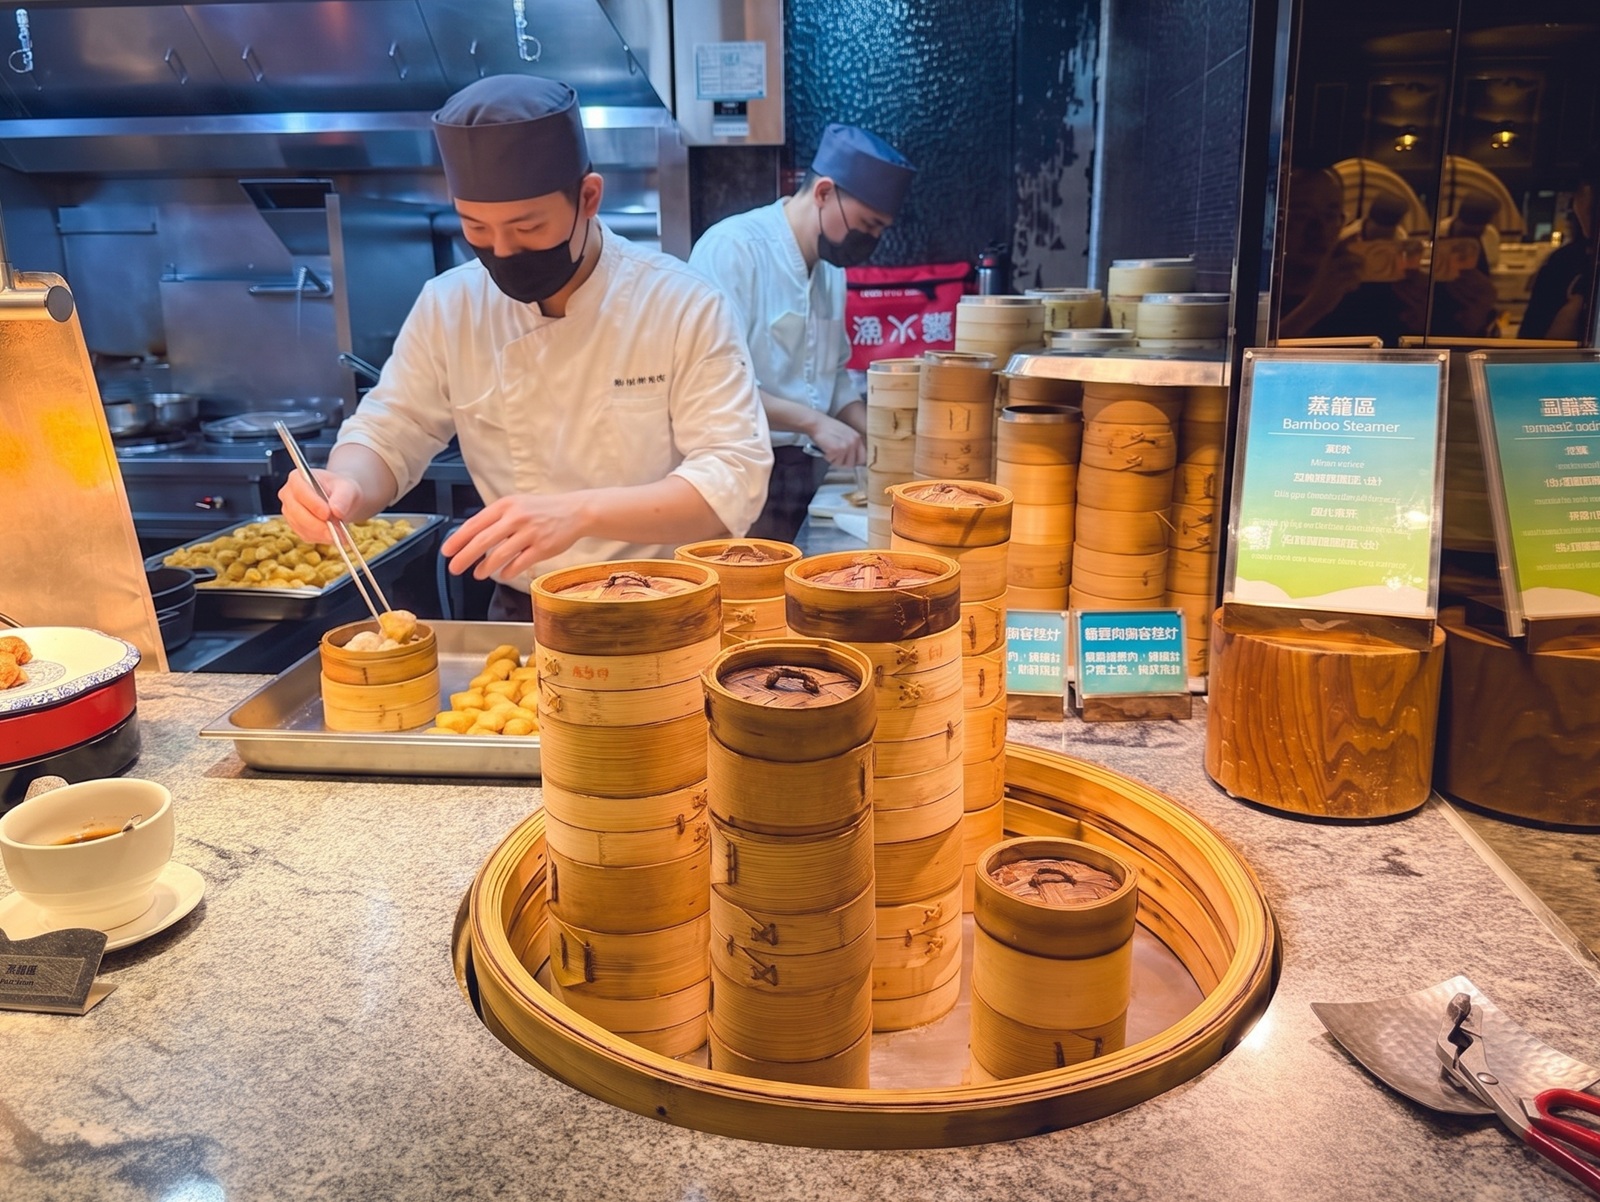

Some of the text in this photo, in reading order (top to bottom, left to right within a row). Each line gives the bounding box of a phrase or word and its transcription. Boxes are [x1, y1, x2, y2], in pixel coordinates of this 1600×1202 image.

[1307, 395, 1377, 417] 蒸籠區
[1282, 418, 1400, 433] Bamboo Steamer
